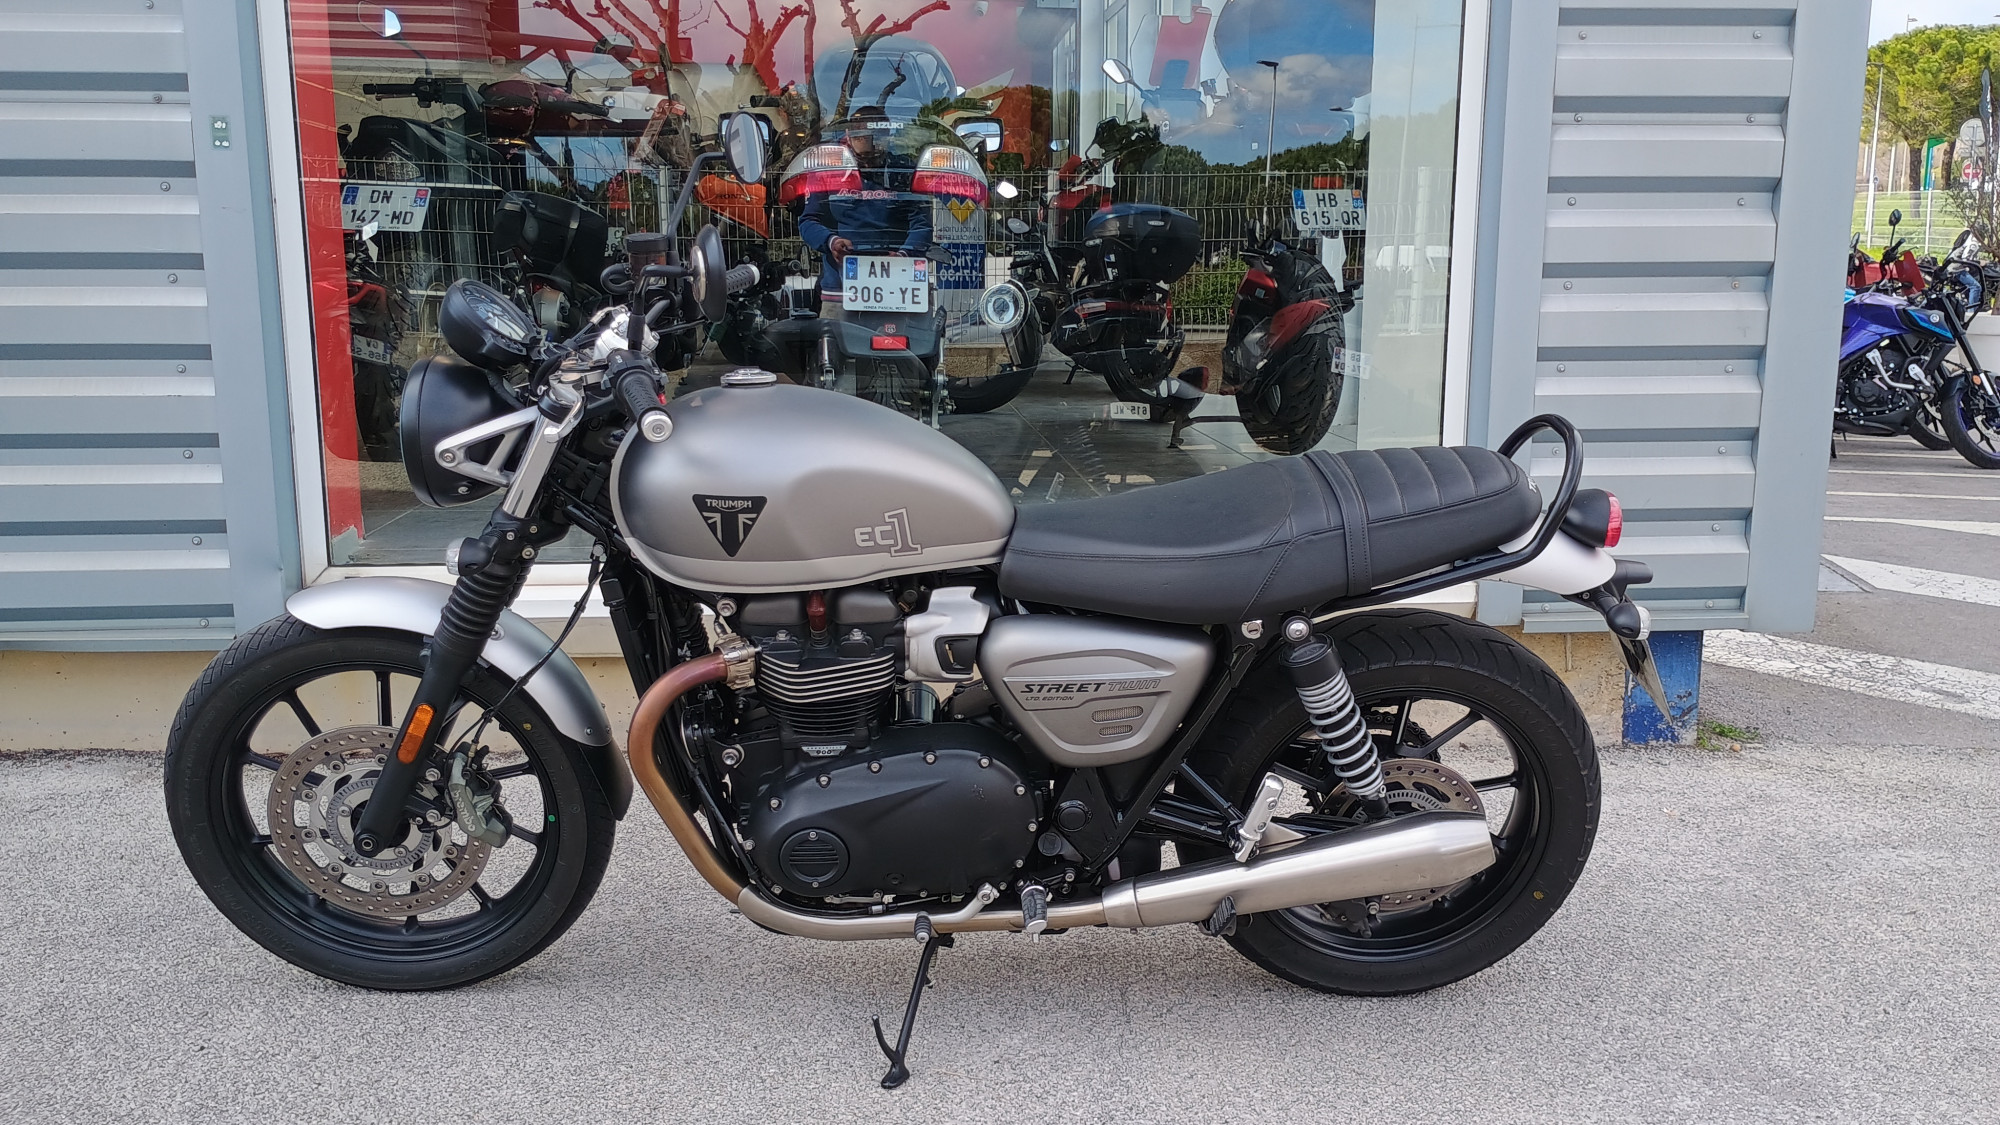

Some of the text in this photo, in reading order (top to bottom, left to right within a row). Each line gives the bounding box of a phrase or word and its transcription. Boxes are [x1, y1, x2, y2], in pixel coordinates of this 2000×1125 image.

[369, 189, 394, 205] DN
[414, 198, 425, 207] 34
[1316, 192, 1339, 208] HB
[350, 209, 414, 226] 147-MD
[1300, 210, 1361, 226] 615-QR
[868, 261, 891, 279] AN
[914, 271, 925, 281] 34
[848, 286, 922, 305] 306-YE
[705, 498, 753, 511] TRIUMPH
[854, 507, 923, 557] EC1
[1020, 682, 1107, 694] STREET
[450, 789, 477, 832] brembo
